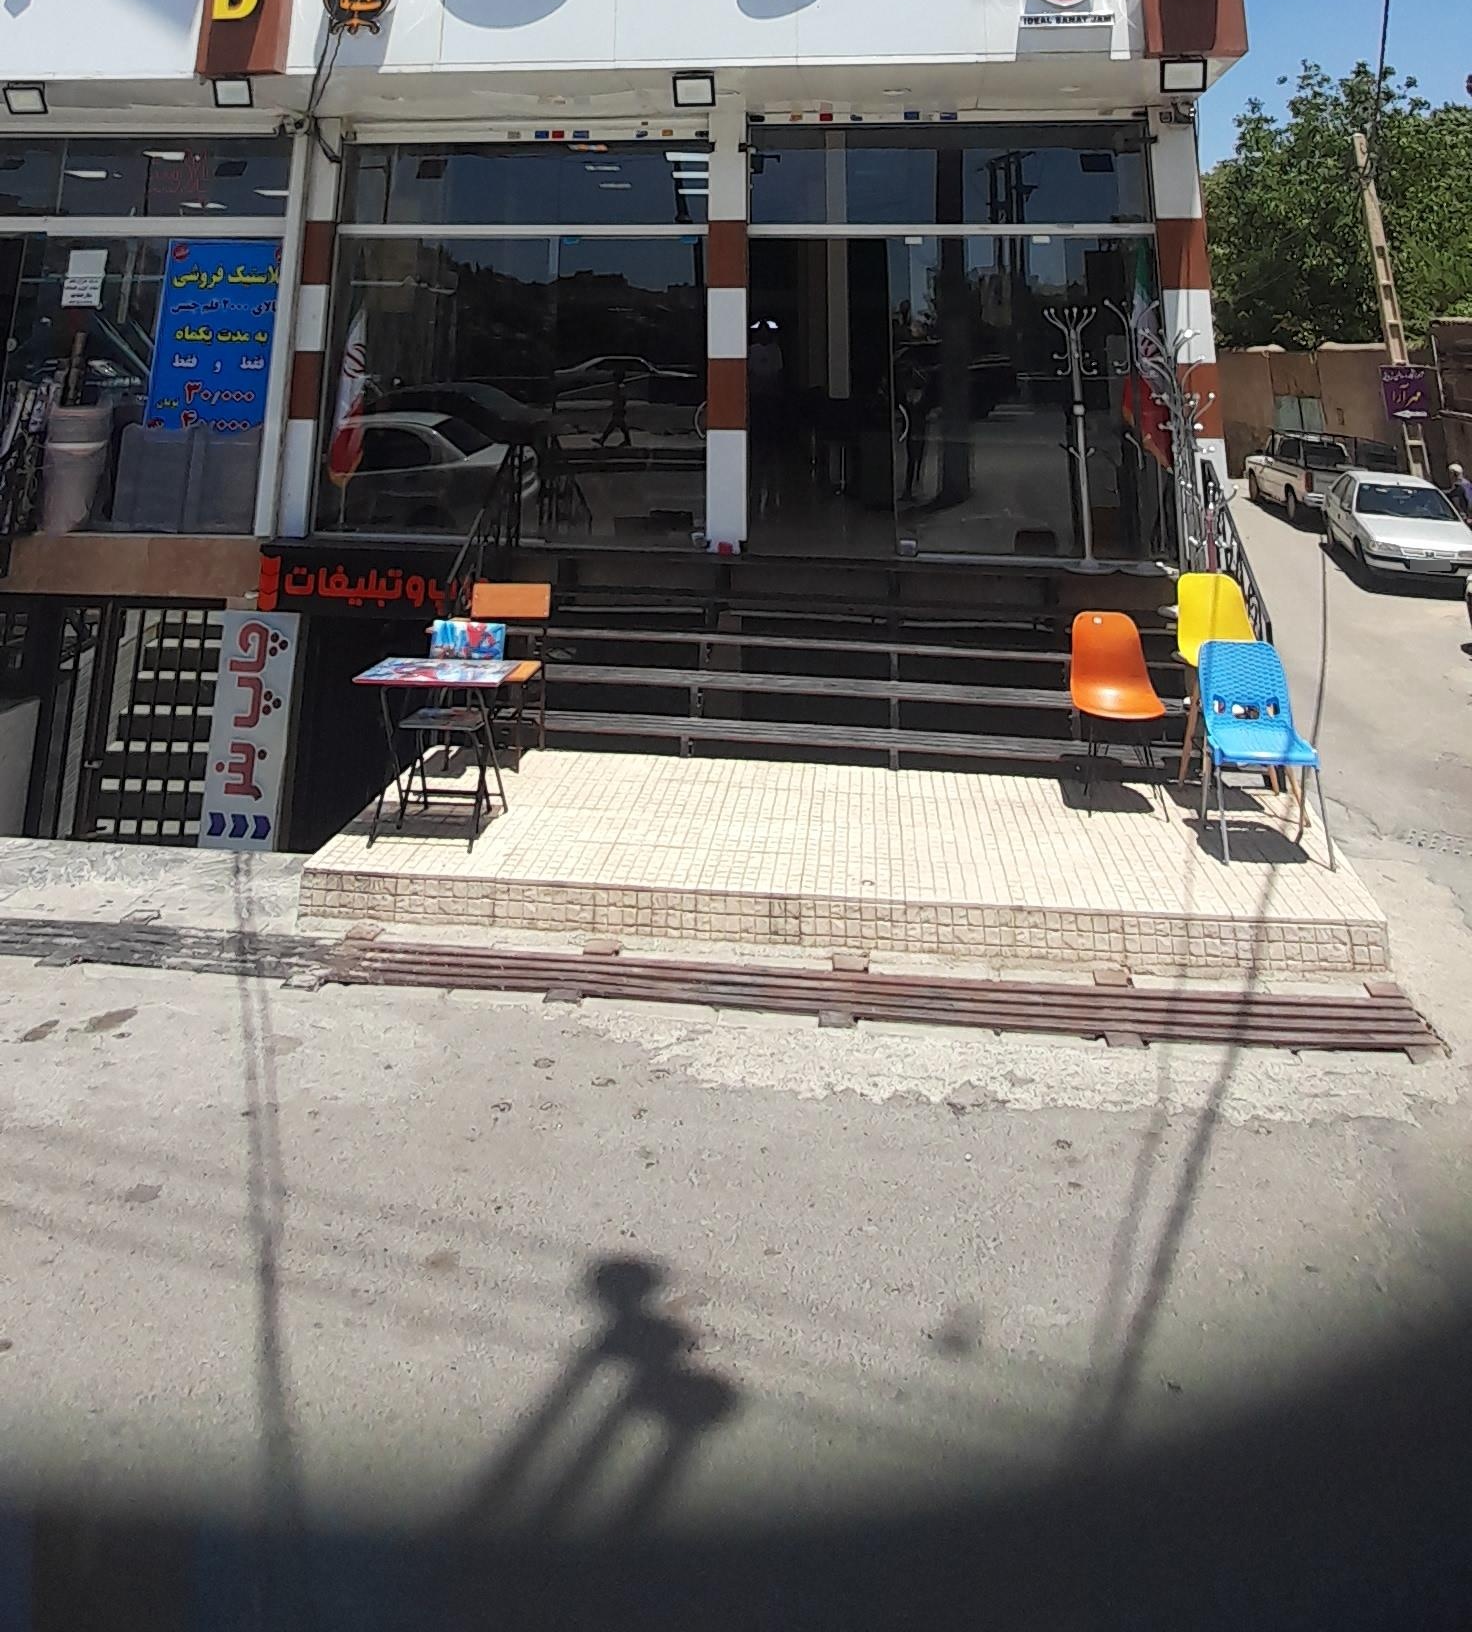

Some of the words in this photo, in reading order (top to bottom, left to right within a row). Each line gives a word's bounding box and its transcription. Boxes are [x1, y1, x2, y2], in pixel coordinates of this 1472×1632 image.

[173, 264, 224, 288] فروشی
[284, 564, 404, 609] تبلیغات
[228, 621, 289, 729] چاپ
[214, 741, 268, 802] بنر
